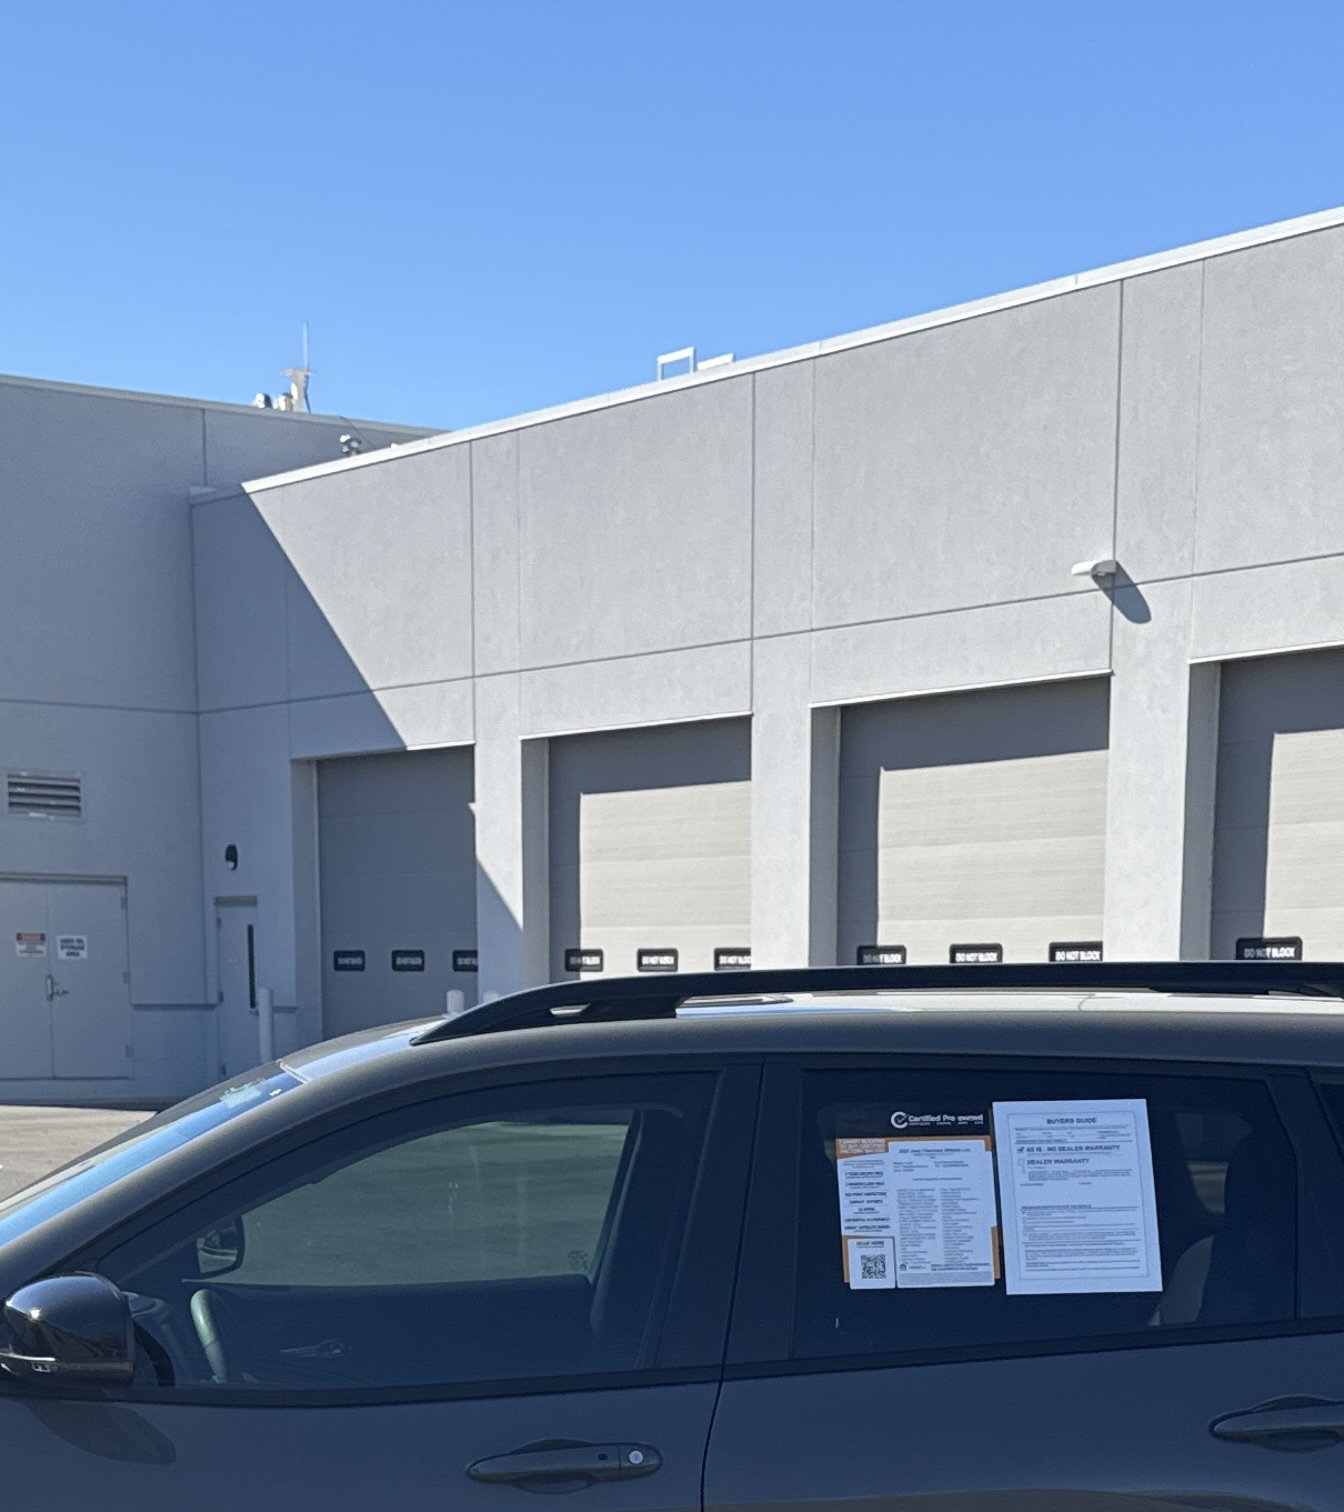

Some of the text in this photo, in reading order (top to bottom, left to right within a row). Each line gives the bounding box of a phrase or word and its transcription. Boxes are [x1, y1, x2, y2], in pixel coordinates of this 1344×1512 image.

[1055, 950, 1101, 961] DO NOT BLOCK
[1244, 947, 1296, 958] DO NOT BLOCK
